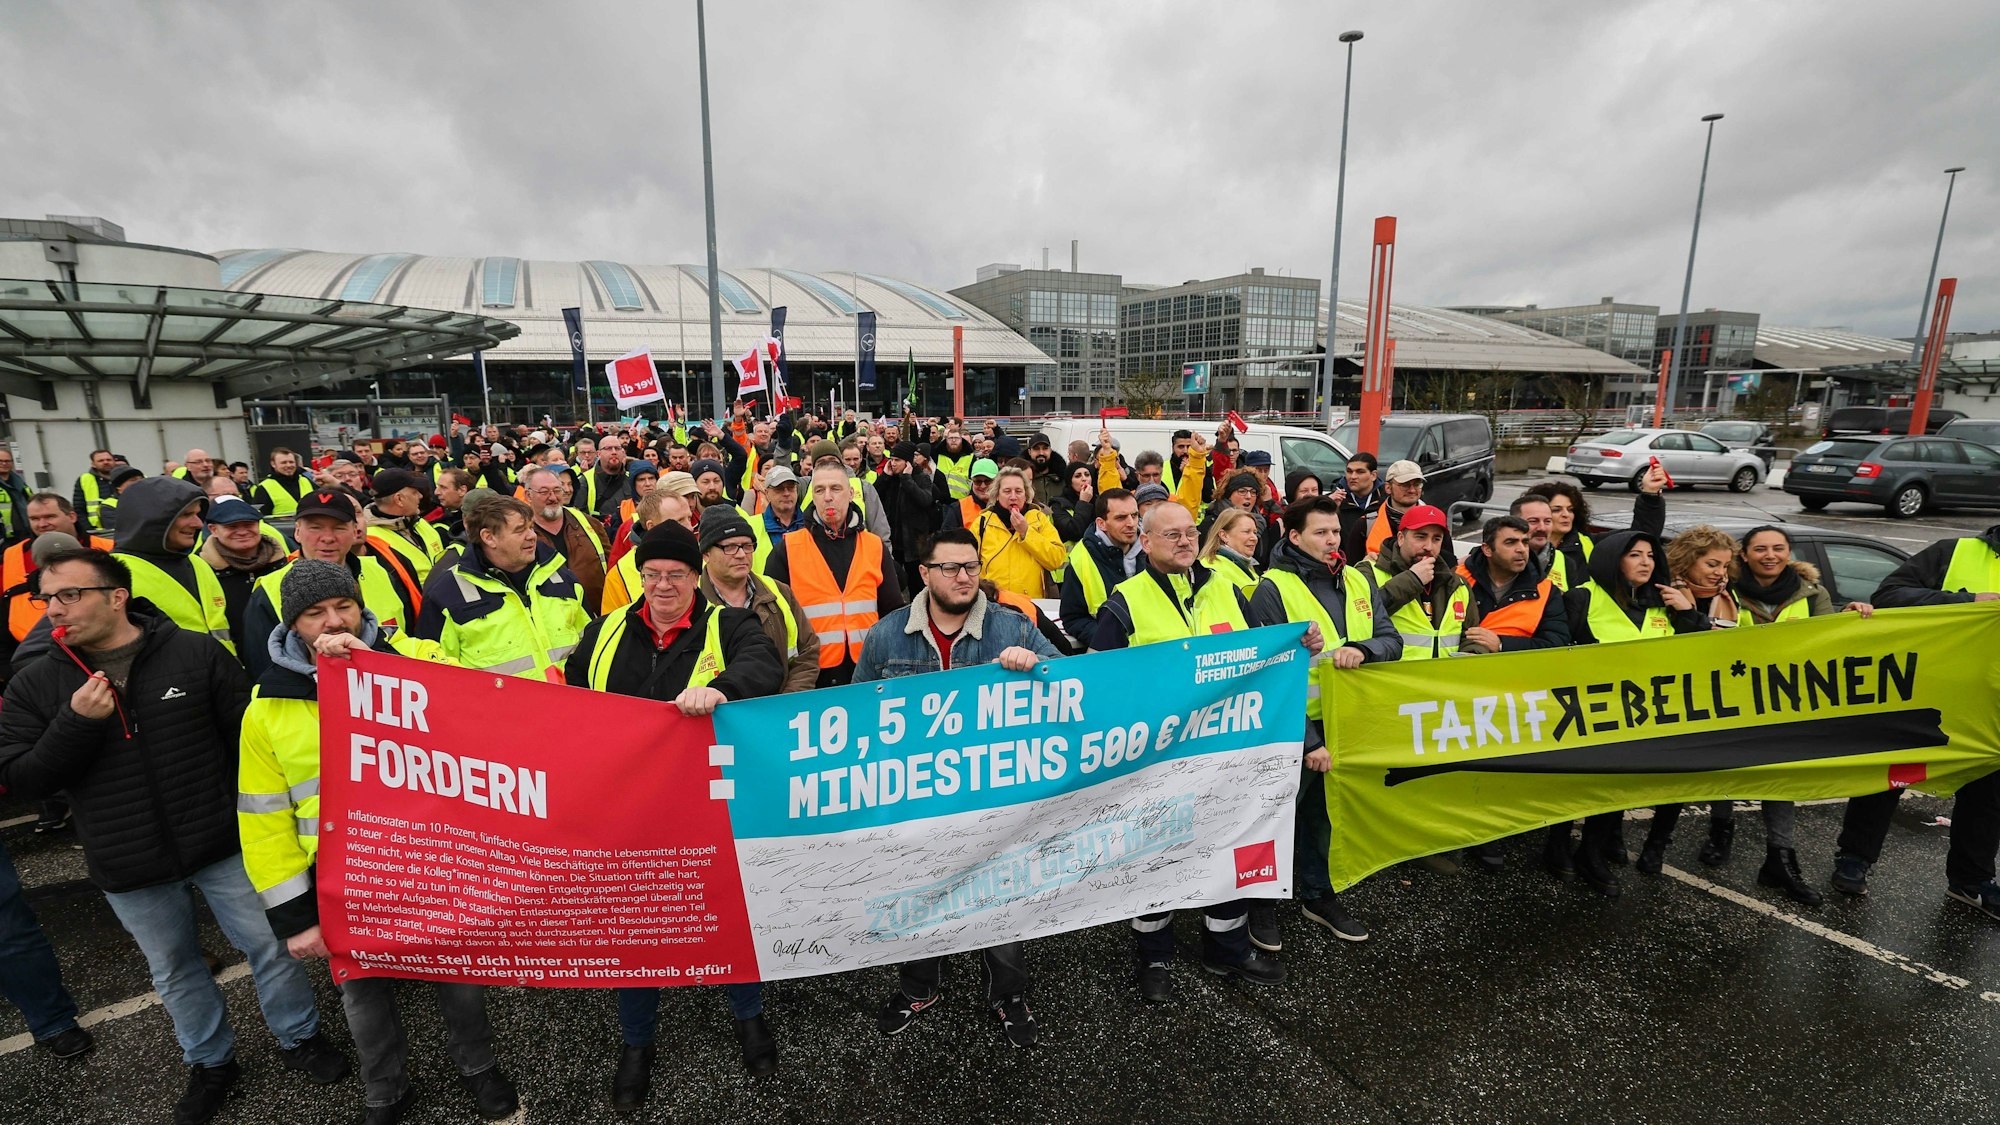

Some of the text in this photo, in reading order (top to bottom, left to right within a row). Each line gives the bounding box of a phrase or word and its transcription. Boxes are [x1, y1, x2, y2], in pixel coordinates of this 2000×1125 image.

[1195, 646, 1258, 668] TARIFRUNDE
[1195, 649, 1296, 685] ÖFFENTLICHER DIENST
[346, 668, 430, 733] WIR
[788, 678, 1084, 762] 10,5 % MEHR
[788, 691, 1263, 820] MINDESTENS 500 € MEHR
[349, 733, 548, 819] FORDERN
[347, 827, 357, 835] so
[360, 827, 382, 839] teuer
[391, 832, 406, 843] das
[409, 834, 452, 849] bestimmt
[455, 843, 487, 857] unseren
[490, 850, 517, 864] Alltag.
[520, 855, 541, 868] Viele
[544, 859, 603, 872] Beschäftigte
[607, 861, 619, 869] im
[622, 859, 678, 869] öffentlichen
[682, 859, 711, 867] Dienst
[348, 810, 717, 858] Inflationsraten um 10 Prozent, fünffache Gaspreise, manche Lebensmittel doppelt
[346, 842, 700, 882] wissen nicht, wie sie die Kosten stemmen können. Die Situation trifft alle hart,
[346, 856, 404, 872] insbesondere
[407, 864, 421, 875] die
[483, 875, 490, 884] in
[493, 876, 508, 889] den
[511, 882, 546, 893] unteren
[549, 884, 626, 895] Entgeltgruppen!
[629, 882, 683, 892] Gleichzeitig
[686, 882, 704, 890] war
[344, 886, 705, 916] immer mehr Aufgaben. Die staatlichen Entlastungspakete federn nur einen Teil
[345, 872, 366, 883] noch
[370, 875, 383, 884] nie
[386, 877, 396, 886] so
[399, 877, 414, 889] viel
[417, 881, 428, 889] zu
[431, 882, 446, 892] tun
[449, 883, 460, 893] im
[463, 885, 511, 904] öffentlichen
[515, 896, 547, 904] Dienst:
[551, 894, 648, 904] Arbeitskräftemangel
[651, 893, 682, 901] überall
[345, 901, 360, 910] der
[459, 913, 494, 926] Deshalb
[497, 919, 512, 928] gilt
[540, 918, 568, 926] dieser
[571, 917, 595, 926] Tarif-
[619, 915, 701, 925] Besoldungsrunde,
[348, 913, 358, 922] im
[362, 914, 391, 925] Januar
[394, 918, 424, 931] startet,
[427, 924, 455, 935] unsere
[458, 928, 506, 938] Forderung
[509, 929, 532, 937] auch
[535, 928, 605, 937] durchzusetzen.
[608, 927, 624, 935] Nur
[628, 926, 680, 936] gemeinsam
[705, 924, 719, 932] wir
[349, 926, 374, 937] stark:
[377, 928, 393, 939] Das
[396, 931, 432, 945] Ergebnis
[435, 937, 462, 947] hängt
[466, 938, 495, 946] davon
[498, 939, 513, 947] ab,
[535, 939, 556, 947] viele
[559, 938, 576, 946] sich
[579, 937, 592, 946] für
[595, 937, 608, 946] die
[612, 937, 658, 946] Forderung
[661, 936, 706, 944] einsetzen.
[351, 950, 620, 966] Mach mit: Stell dich hinter unsere
[359, 960, 731, 980] gemeinsame Forderung und unterschreib dafür!
